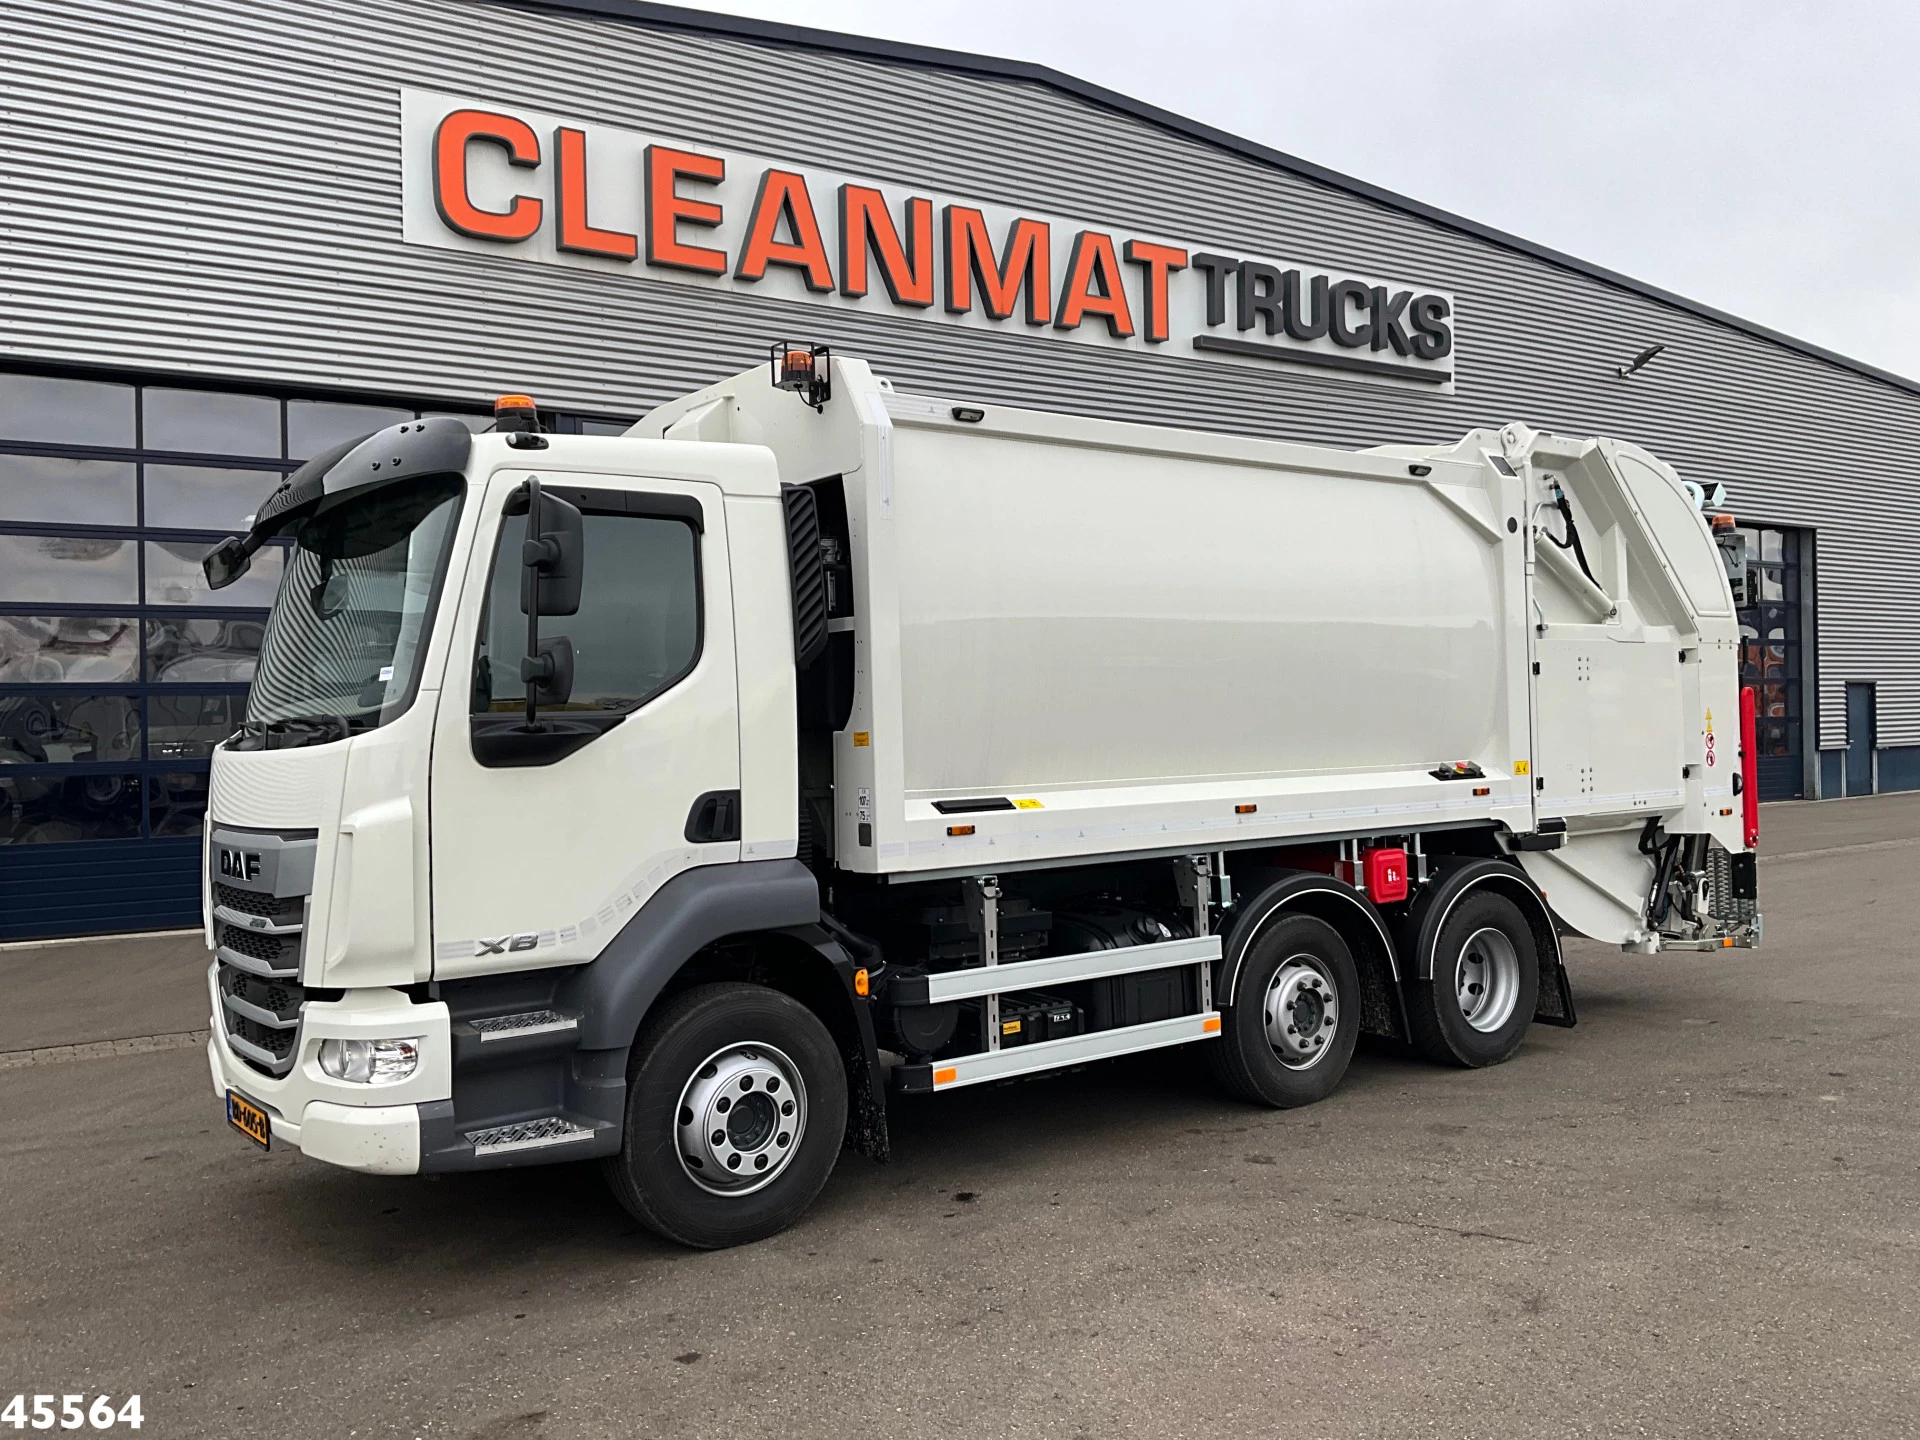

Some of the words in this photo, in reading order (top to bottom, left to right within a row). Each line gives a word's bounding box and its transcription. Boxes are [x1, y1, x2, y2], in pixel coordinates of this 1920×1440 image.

[432, 108, 1188, 344] CLEANMAT
[1192, 252, 1452, 361] TRUCKS
[220, 848, 261, 882] DAF
[474, 931, 539, 957] XB
